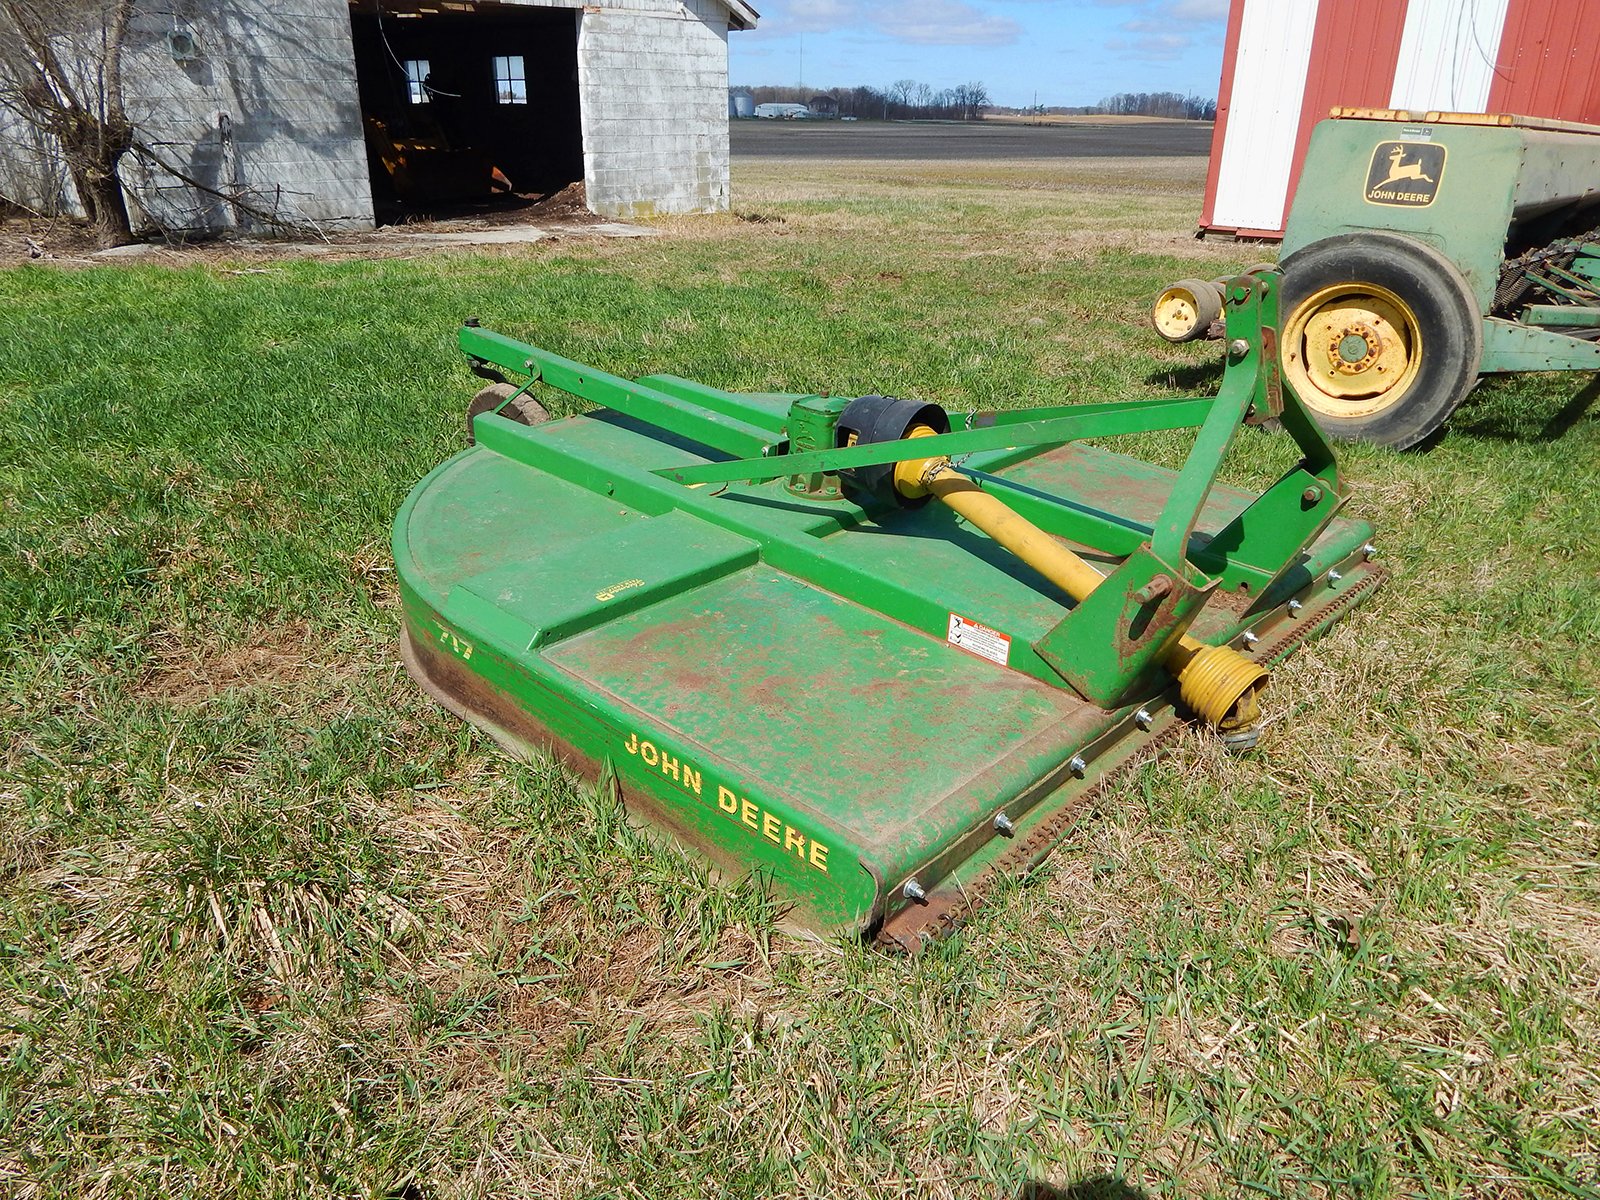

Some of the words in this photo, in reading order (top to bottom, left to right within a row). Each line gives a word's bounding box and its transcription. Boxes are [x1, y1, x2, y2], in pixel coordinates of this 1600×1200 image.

[1368, 191, 1395, 200] JOHN
[1397, 192, 1430, 203] DEERE
[624, 732, 702, 795] JOHN
[718, 784, 829, 872] DEERE
